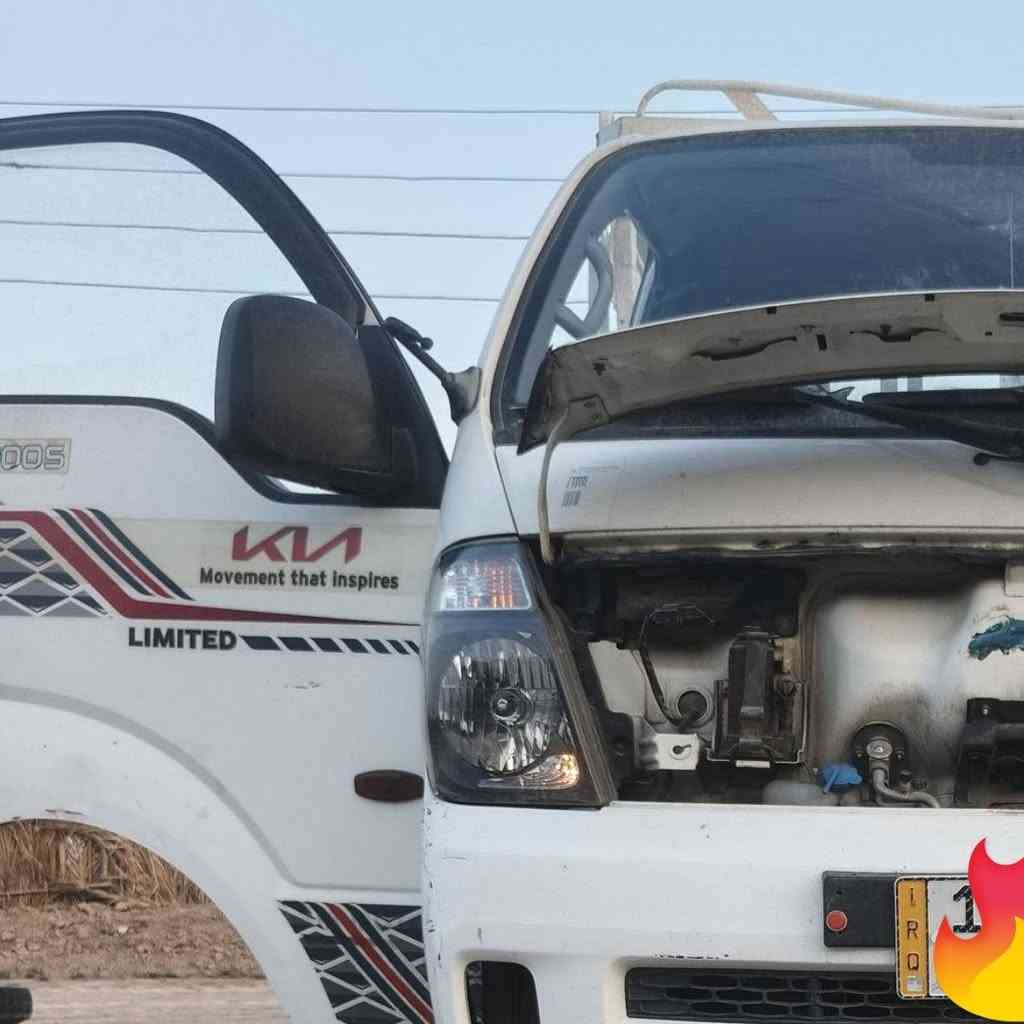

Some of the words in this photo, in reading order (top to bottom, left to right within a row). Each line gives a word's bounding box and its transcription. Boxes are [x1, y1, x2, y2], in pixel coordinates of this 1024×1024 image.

[231, 525, 363, 564] KIA
[199, 567, 285, 587] Movement
[290, 569, 327, 588] that
[332, 570, 399, 591] inspires
[128, 626, 237, 651] LIMITED
